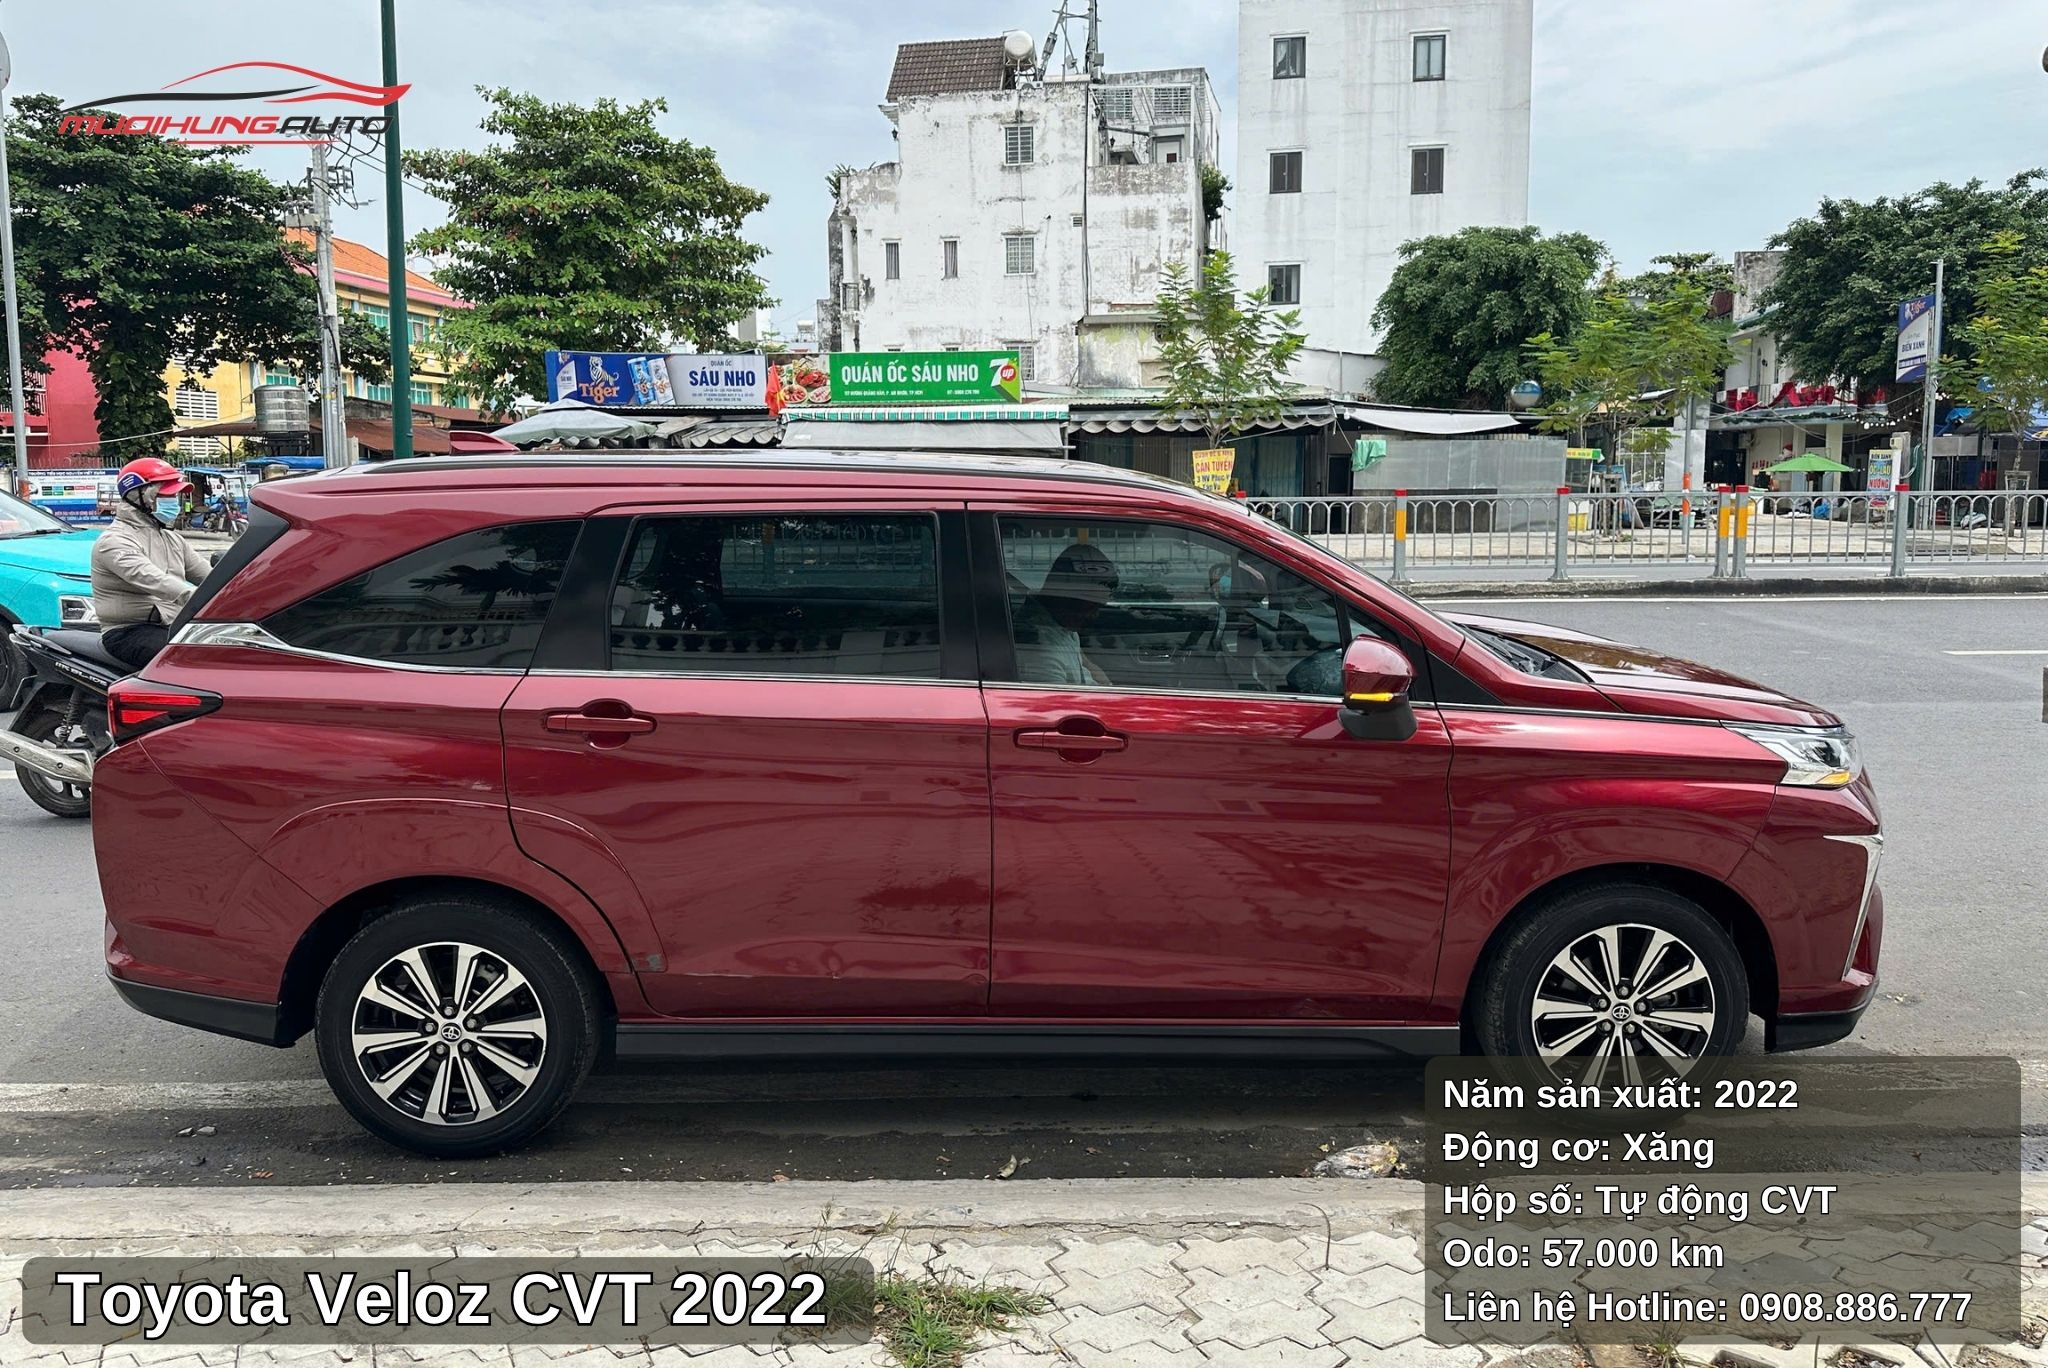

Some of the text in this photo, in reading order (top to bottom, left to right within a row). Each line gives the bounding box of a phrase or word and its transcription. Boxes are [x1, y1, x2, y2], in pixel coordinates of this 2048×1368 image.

[688, 366, 756, 387] SÁU NHO
[841, 360, 979, 385] QUÁN ỐC SÁU NHO
[578, 381, 620, 405] Tiger
